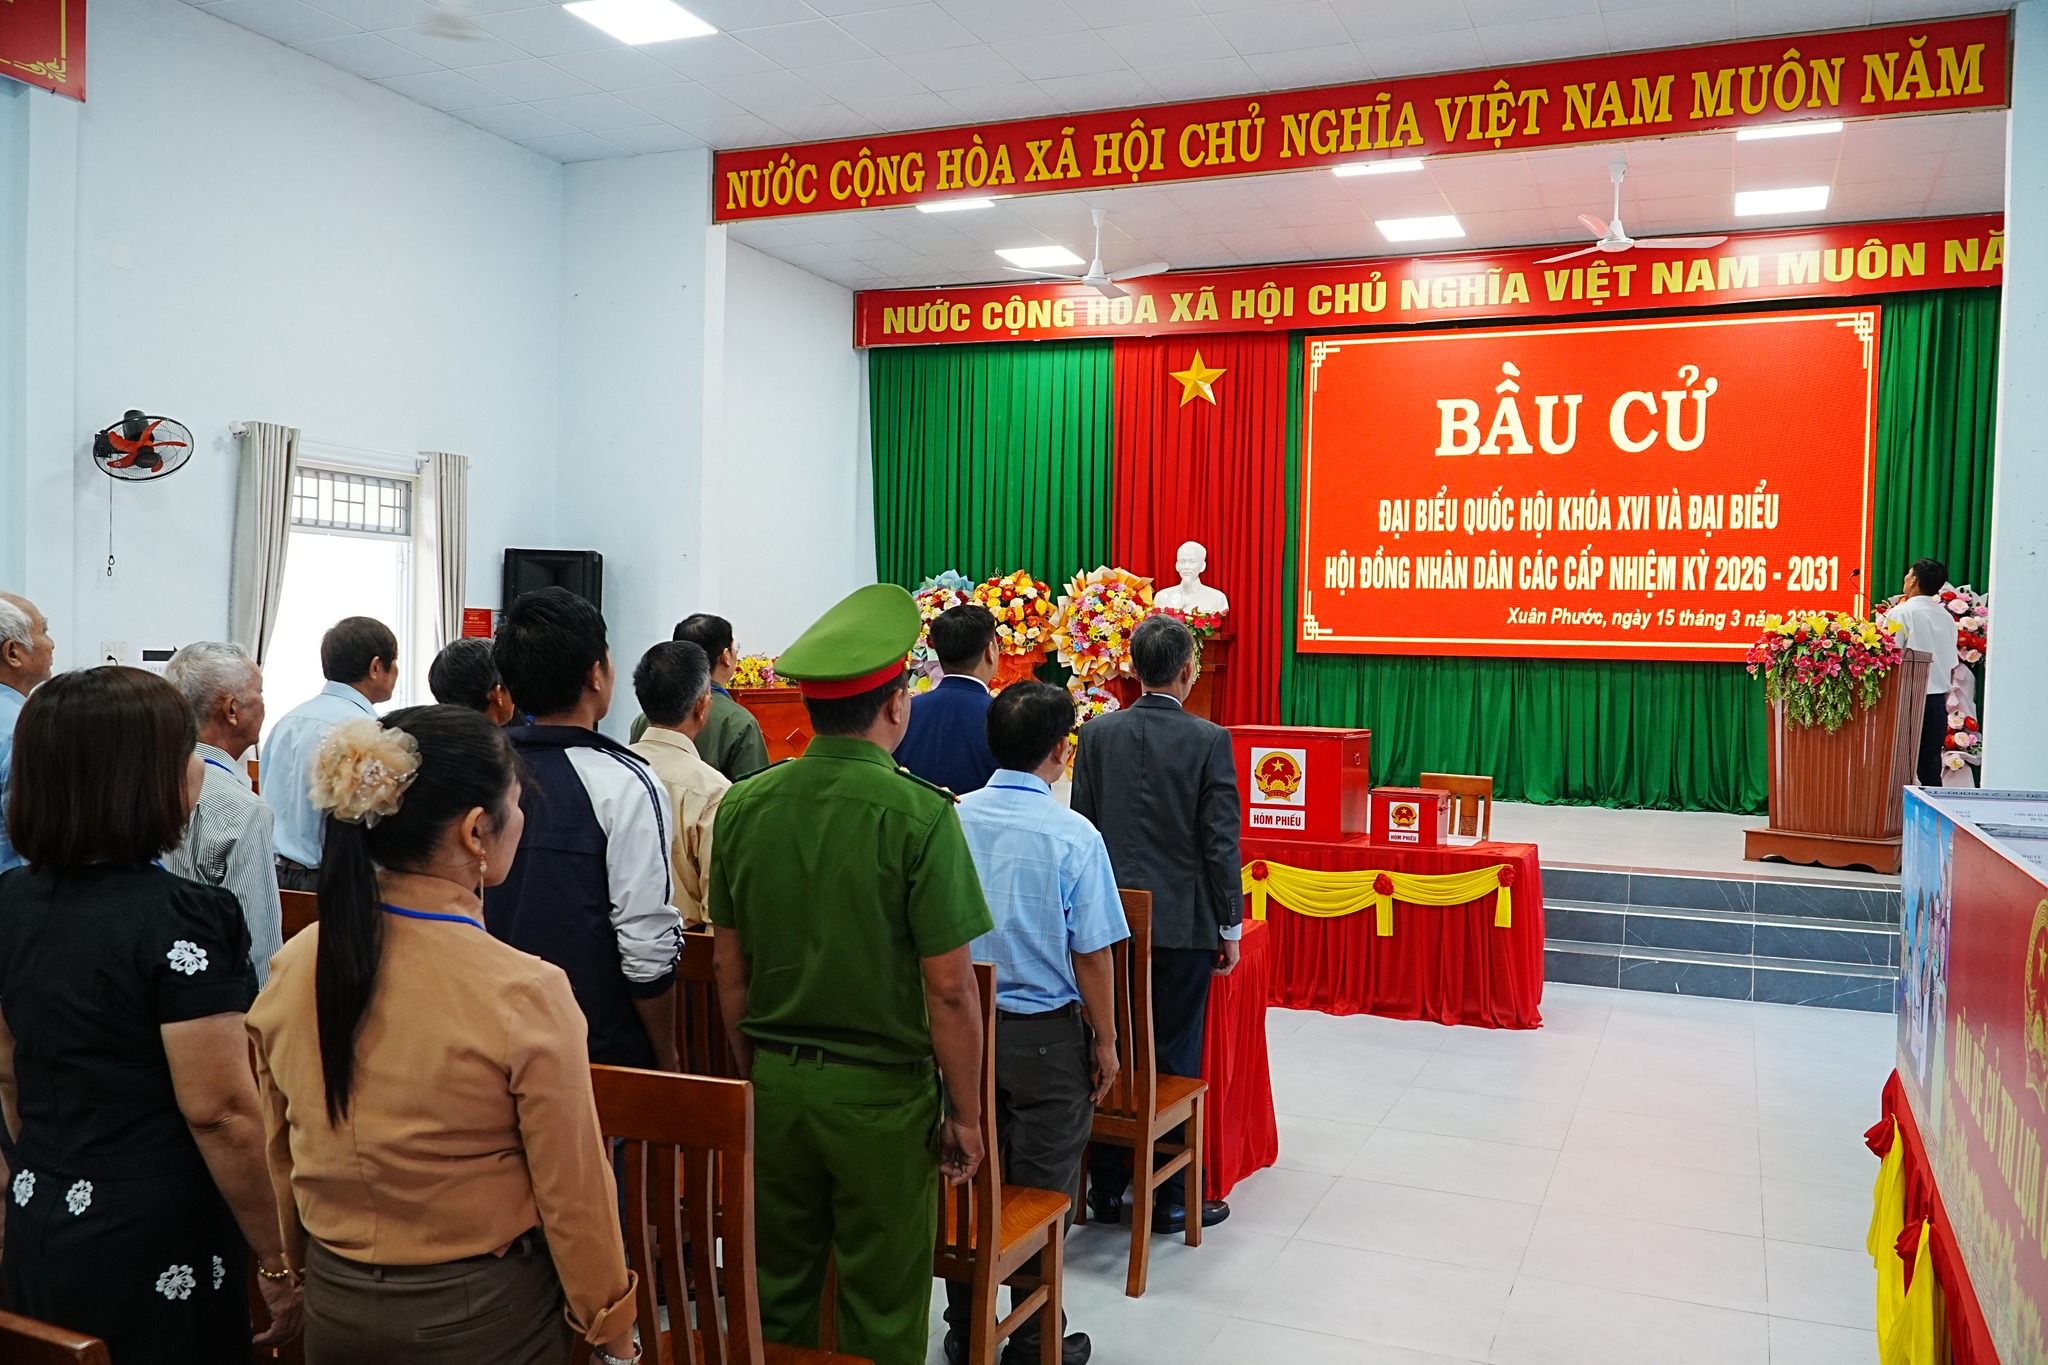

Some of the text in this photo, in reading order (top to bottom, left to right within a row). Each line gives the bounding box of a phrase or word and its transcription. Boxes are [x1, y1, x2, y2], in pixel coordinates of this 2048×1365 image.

[726, 36, 1984, 209] NƯỚC CỘNG HÒA XÃ HỘI CHỦ NGHĨA VIỆT NAM MUÔN NĂM
[884, 299, 970, 333] NƯỚC
[983, 294, 1075, 336] CỘNG
[1169, 286, 1218, 322] XÃ
[1232, 282, 1293, 321] HỘI
[1309, 272, 1386, 316] CHỦ
[1401, 267, 1527, 309] NGHĨA
[1545, 259, 1637, 305] VIỆT
[1652, 254, 1760, 294] NAM
[1777, 238, 1925, 287] MUÔN
[1435, 361, 1718, 456] BẦU CỬ
[1379, 479, 1779, 539] ĐẠI BIỂU QUỐC HỘI KHÓA XVI VÀ ĐẠI BIỂU
[1325, 550, 1355, 595] HỘI
[1360, 545, 1410, 589] ĐỒNG
[1416, 550, 1468, 589] NHÂN
[1474, 549, 1513, 589] DÂN
[1519, 549, 1557, 590] CÁC
[1564, 544, 1603, 590] CẤP
[1609, 549, 1676, 598] NHIỆM
[1682, 549, 1709, 590] KỲ
[1715, 556, 1766, 591] 2026
[1787, 556, 1838, 591] 2031
[1507, 607, 1546, 624] Xuân
[1551, 608, 1606, 627] Phước,
[1612, 609, 1652, 629] ngày
[1657, 609, 1675, 625] 15
[1679, 609, 1726, 630] tháng
[1730, 610, 1740, 626] 3
[1253, 812, 1301, 827] HÒM PHIẾU
[1998, 1085, 2018, 1190] TRI
[2014, 1117, 2041, 1240] LỰA
